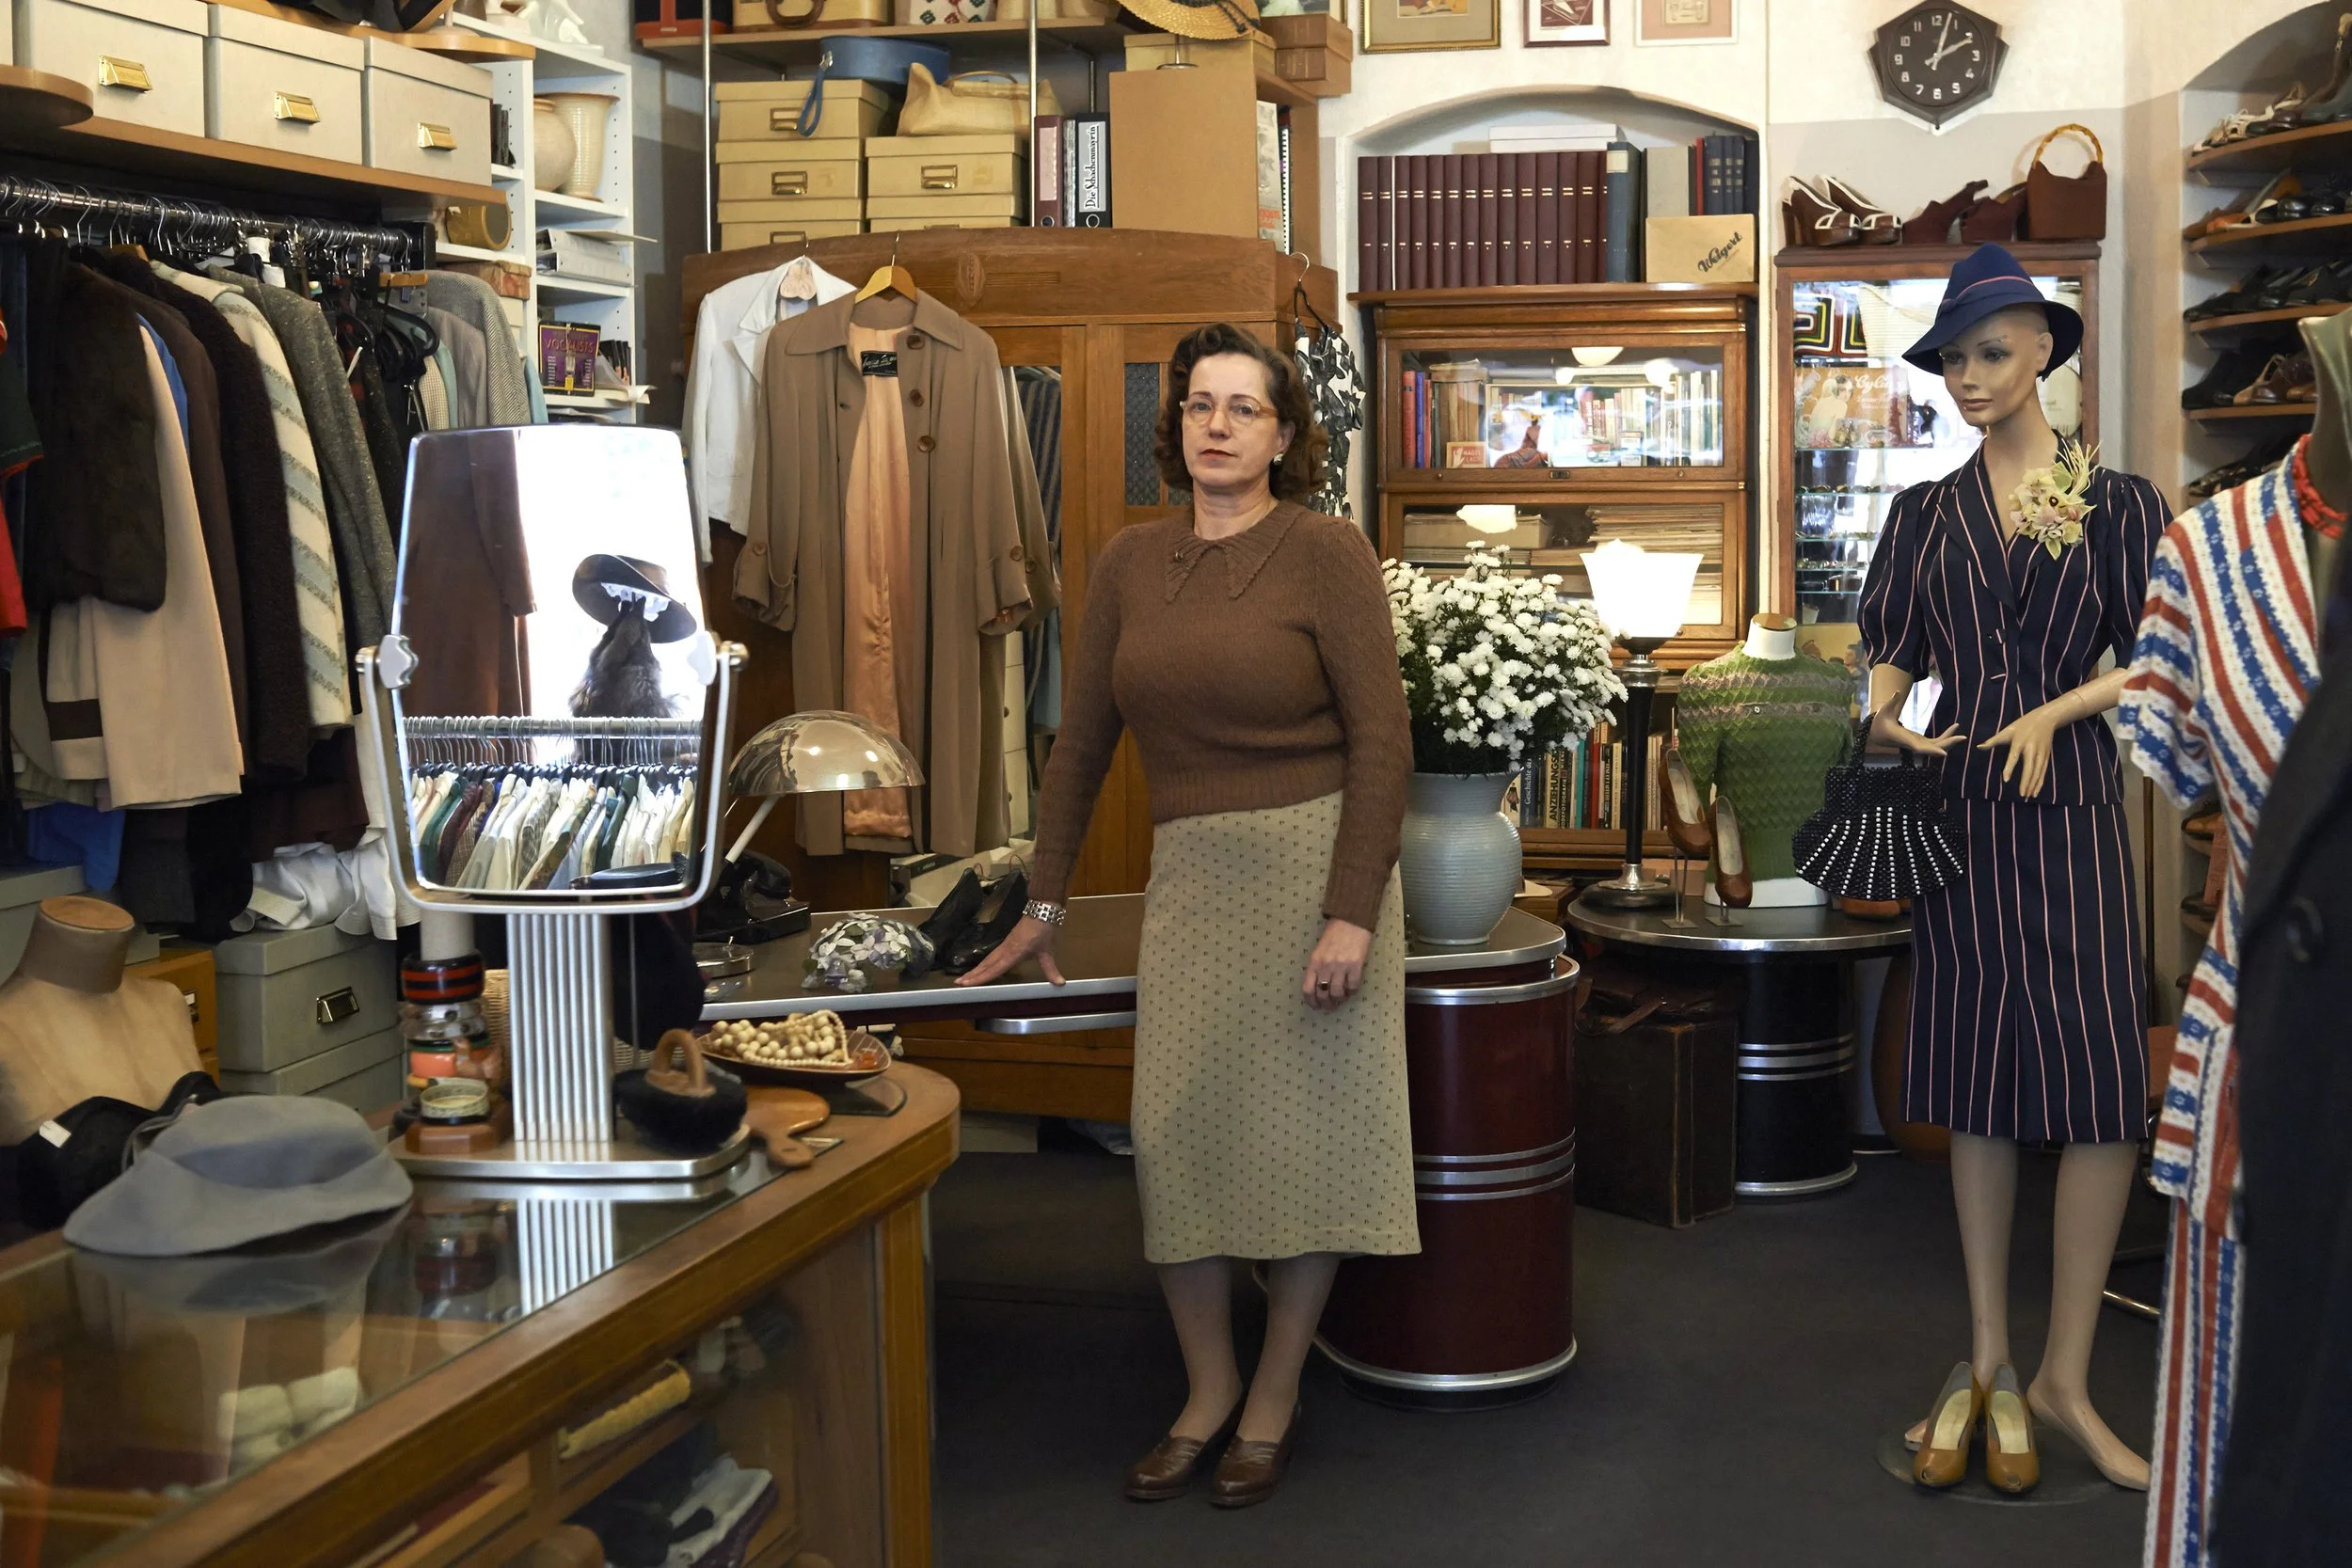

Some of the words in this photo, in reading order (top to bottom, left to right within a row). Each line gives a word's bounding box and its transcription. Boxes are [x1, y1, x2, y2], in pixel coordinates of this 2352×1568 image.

[1931, 15, 1943, 26] 12
[1954, 19, 1959, 30] 1
[1914, 21, 1922, 32] 11
[1900, 36, 1911, 47] 10
[1894, 54, 1903, 65] 9
[1972, 50, 1980, 61] 3
[1901, 71, 1910, 83] 8
[1965, 68, 1975, 78] 4
[1915, 84, 1924, 95] 7
[1932, 87, 1942, 100] 6
[1952, 82, 1961, 94] 5
[1085, 192, 1096, 208] Die
